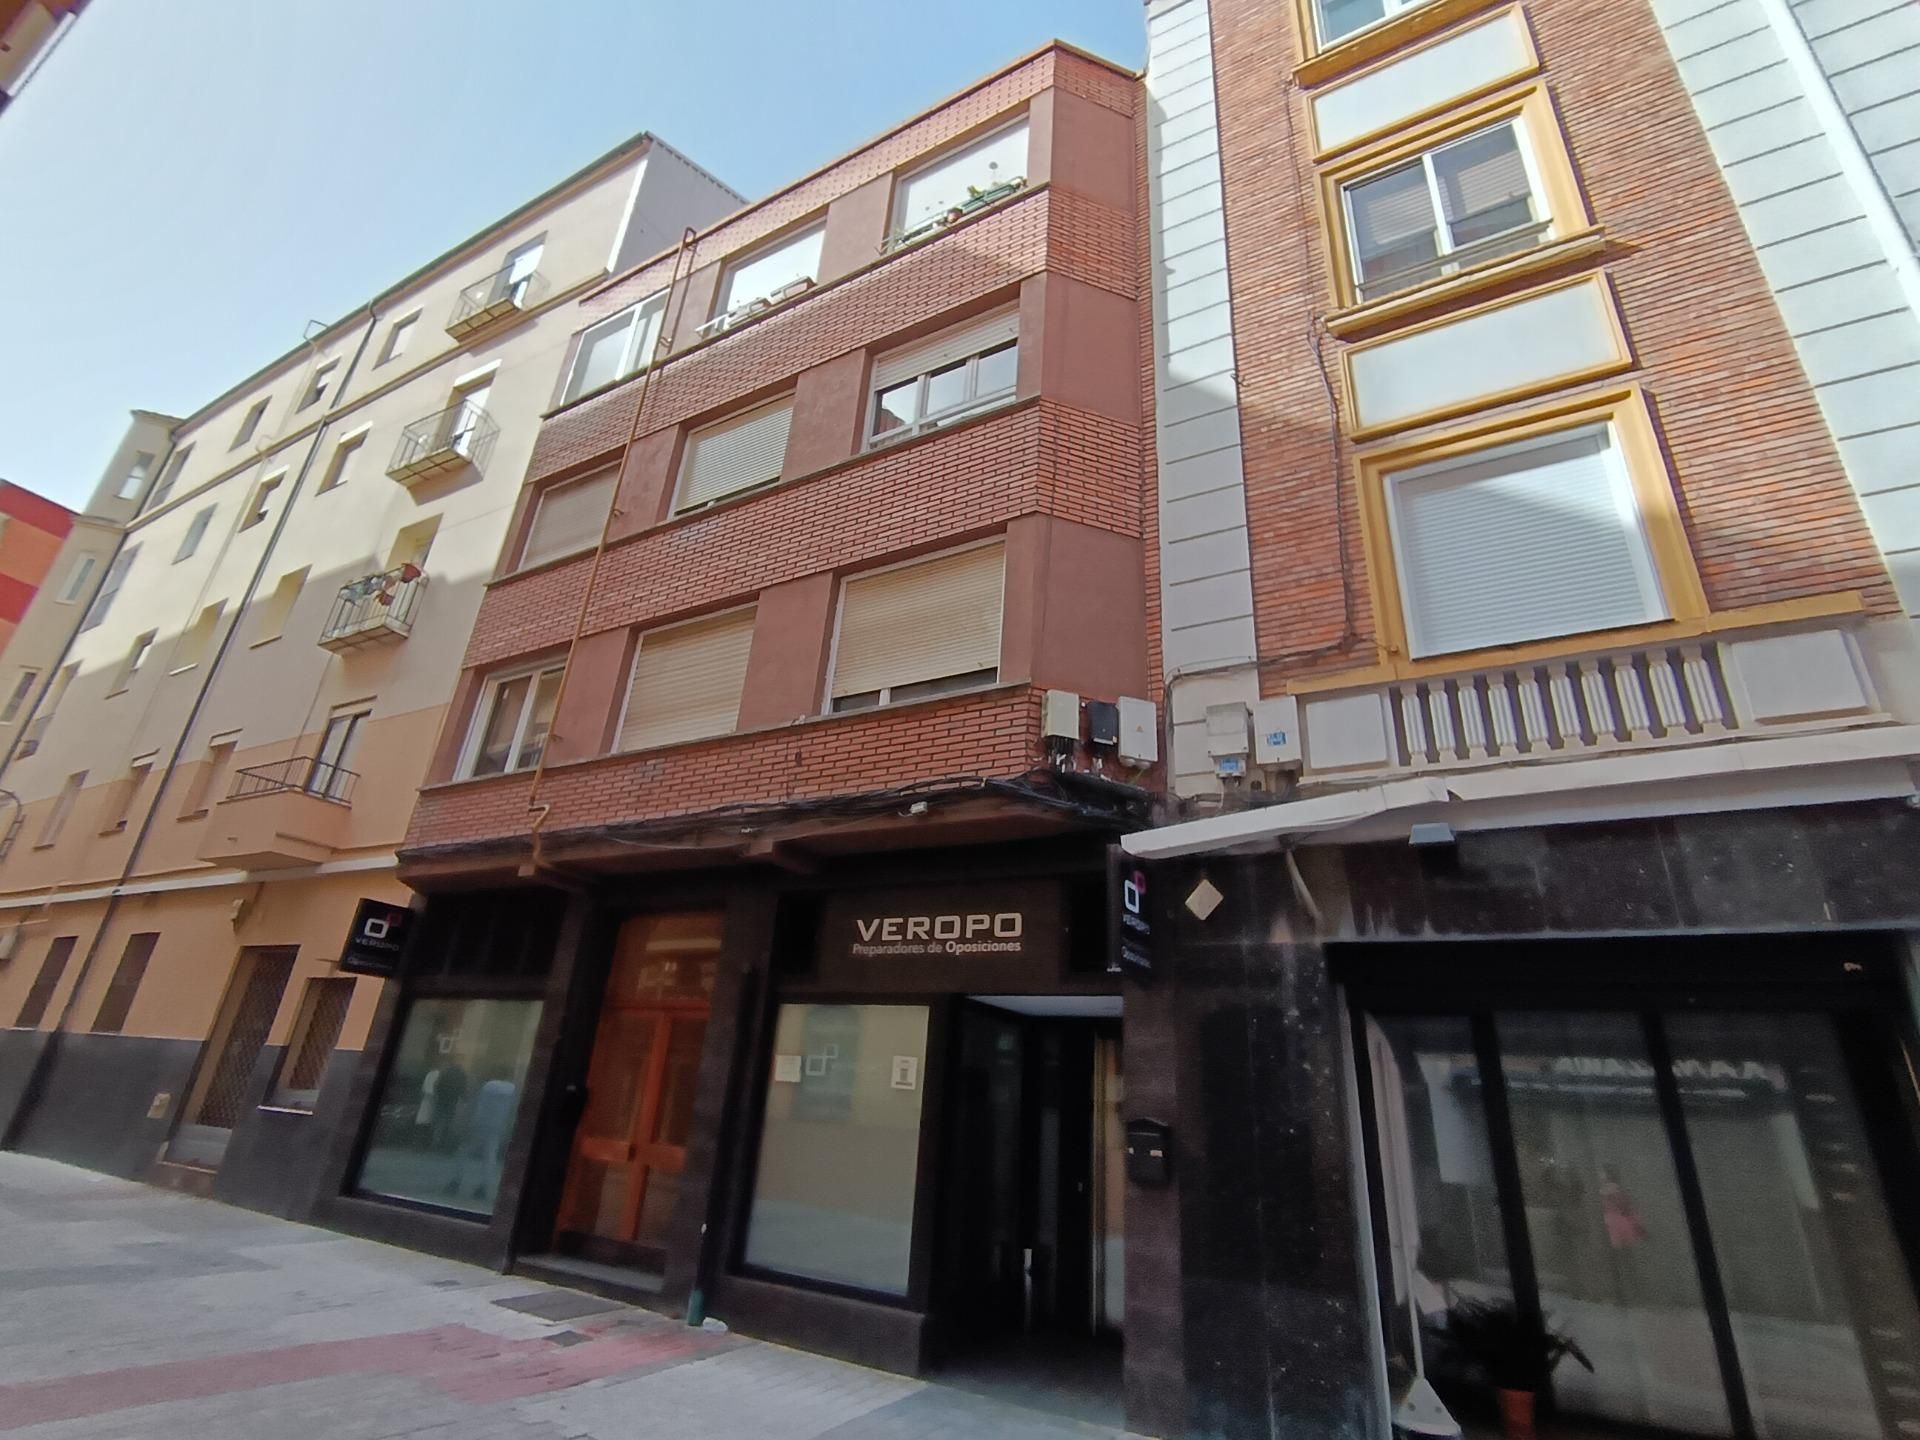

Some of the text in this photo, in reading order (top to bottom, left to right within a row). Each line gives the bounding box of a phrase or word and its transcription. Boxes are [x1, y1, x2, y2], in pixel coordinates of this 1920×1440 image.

[857, 913, 1022, 942] VEROPO
[852, 940, 1021, 957] Preparadores de Oposiciones
